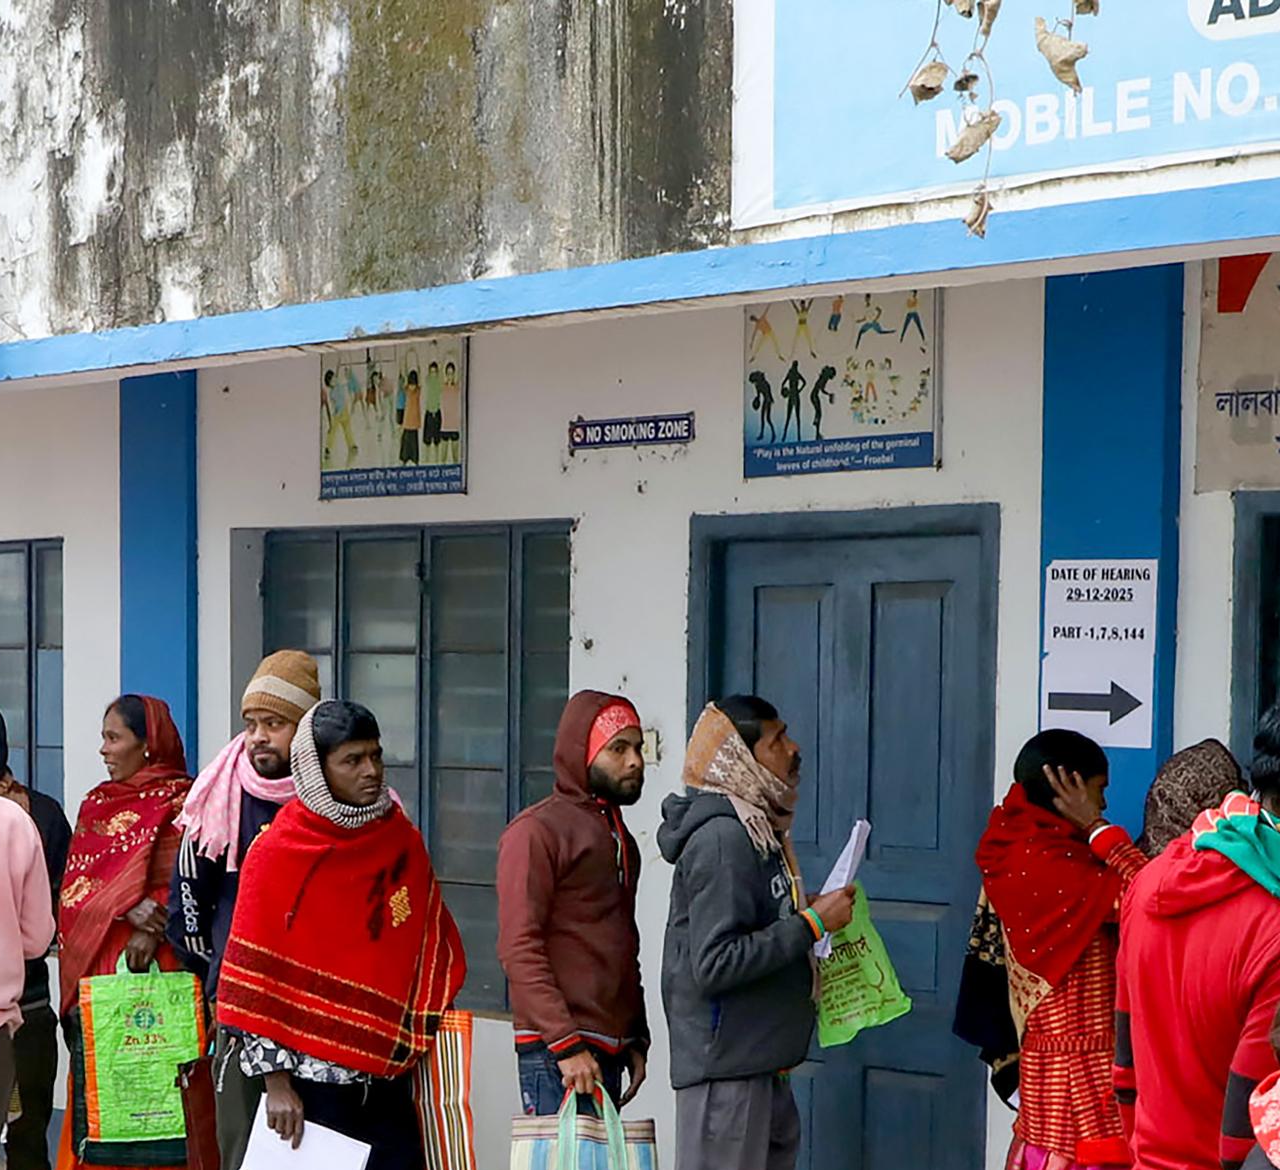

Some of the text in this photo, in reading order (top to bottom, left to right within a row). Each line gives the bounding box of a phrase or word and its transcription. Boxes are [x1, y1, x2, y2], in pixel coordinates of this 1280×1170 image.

[935, 77, 1151, 158] MOBILE
[1172, 62, 1278, 124] NO.
[586, 420, 689, 443] NO SMOKING ZONE
[782, 445, 795, 457] the
[824, 441, 861, 455] unfolding
[862, 439, 870, 451] of
[871, 438, 884, 450] the
[802, 459, 810, 470] of
[864, 455, 894, 466] Froebel
[1051, 568, 1151, 581] DATE OF HEARING
[1066, 588, 1134, 602] 29-12-2025
[1052, 626, 1082, 640] PART
[181, 881, 200, 933] adidas
